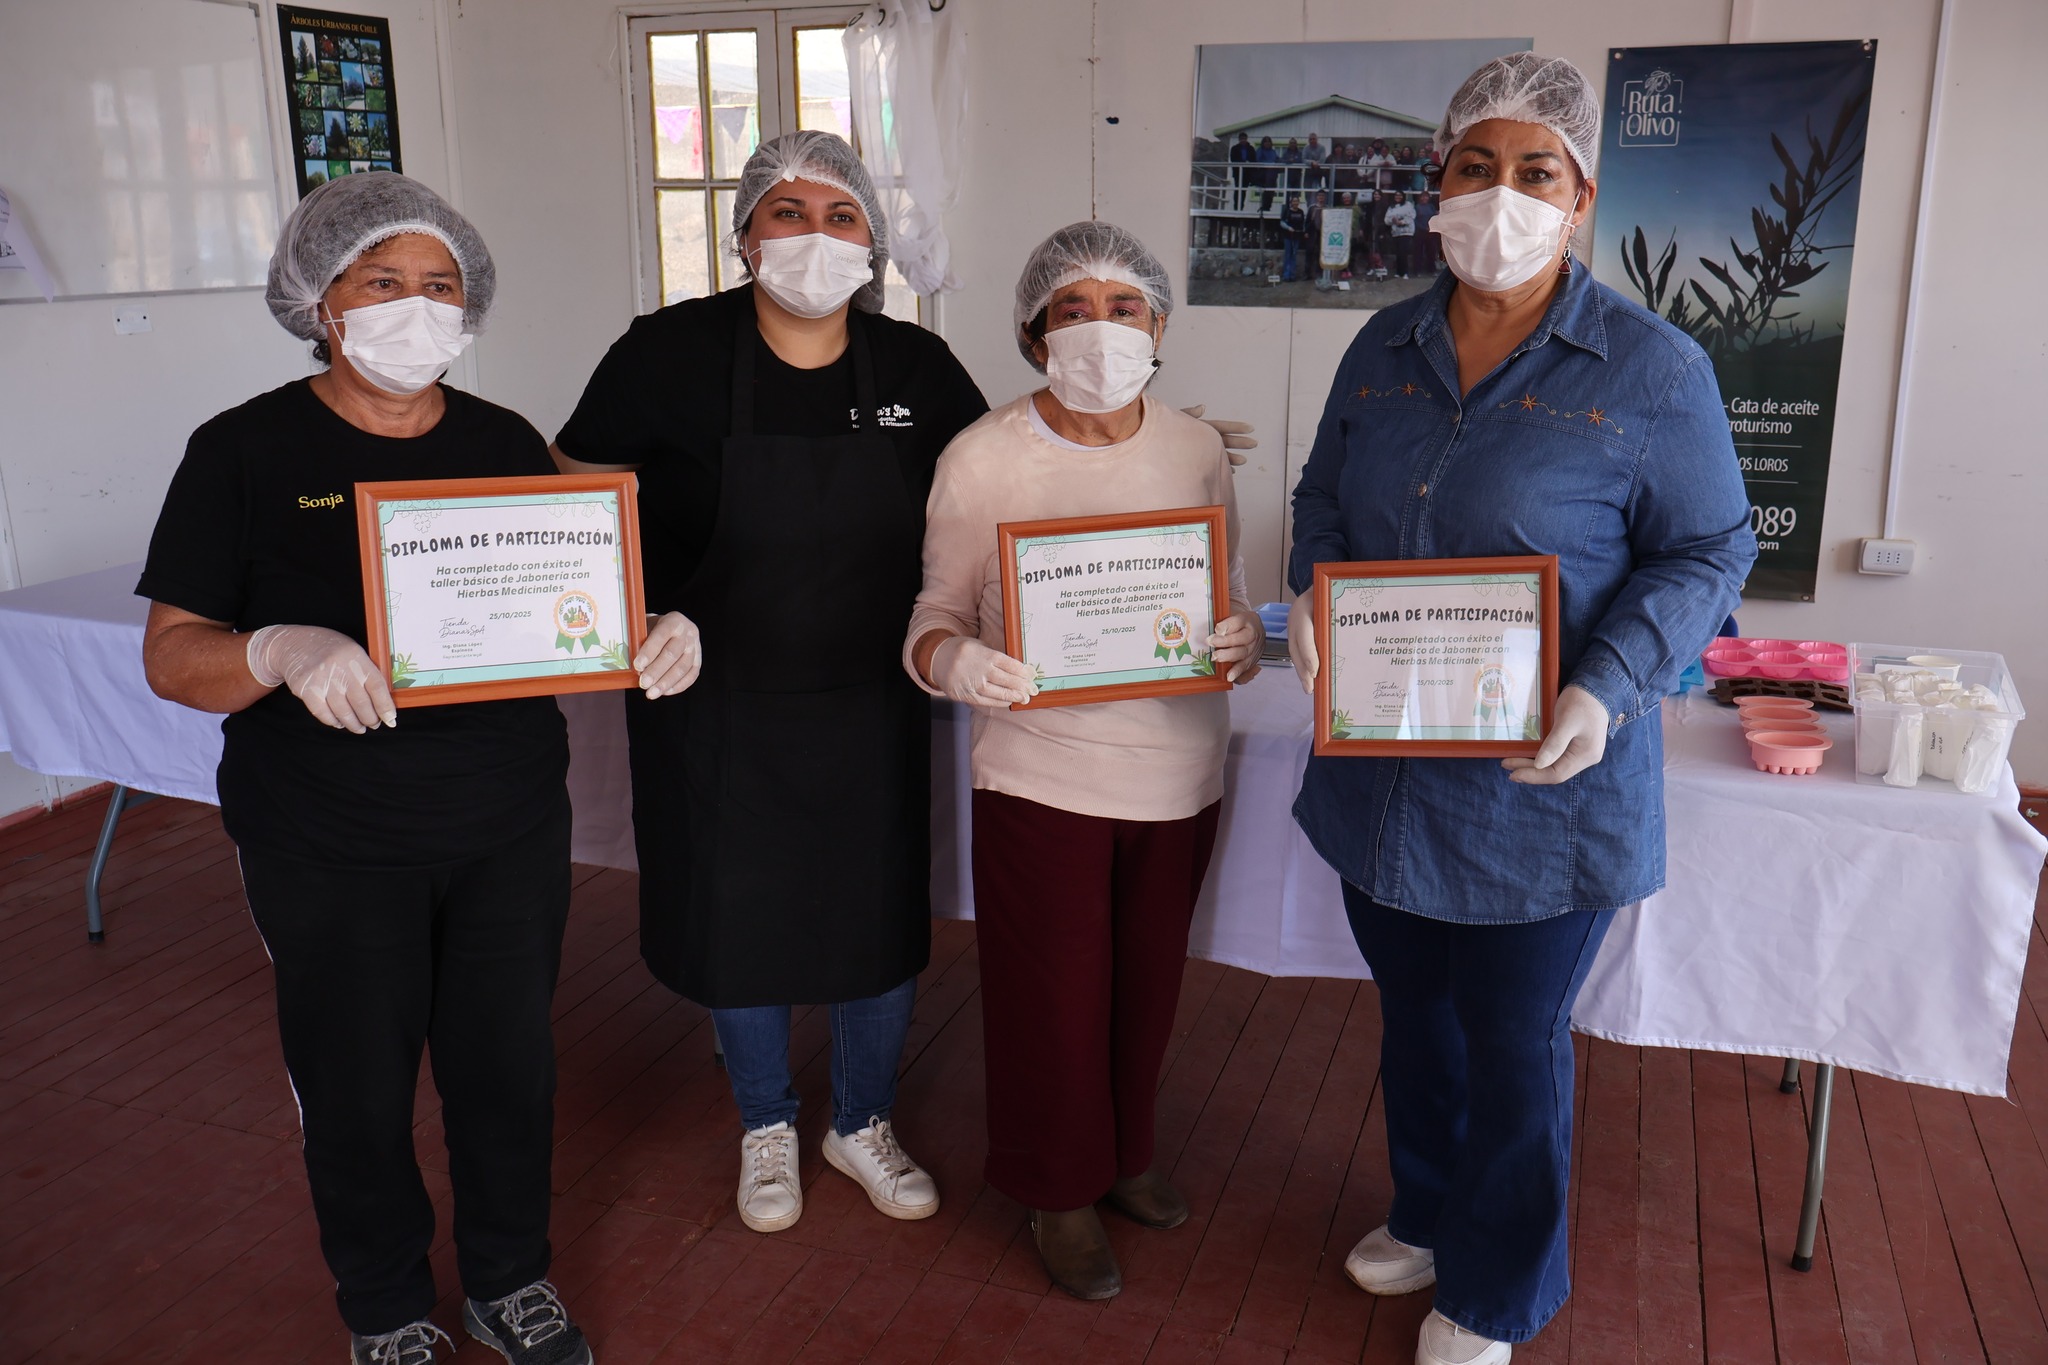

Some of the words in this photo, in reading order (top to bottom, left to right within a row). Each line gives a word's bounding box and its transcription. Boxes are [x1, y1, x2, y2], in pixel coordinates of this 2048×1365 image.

[290, 13, 320, 27] ÁRBOLES
[321, 19, 350, 30] URBANOS
[360, 24, 377, 33] CHILE
[1629, 91, 1674, 113] Ruta
[1627, 114, 1675, 136] Olivo
[893, 404, 910, 418] Spa
[1731, 397, 1759, 413] Cata
[1762, 398, 1778, 414] de
[1781, 400, 1819, 415] aceite
[1728, 418, 1792, 434] roturismo
[1739, 457, 1752, 470] OS
[1754, 458, 1788, 472] LOROS
[298, 493, 344, 509] Sonja
[391, 536, 463, 557] DIPLOMA
[471, 533, 489, 547] DE
[496, 529, 613, 546] PARTICIPACIÓN
[1756, 541, 1779, 550] om
[437, 567, 450, 575] Ha
[454, 562, 518, 574] completado
[543, 560, 570, 569] éxito
[573, 559, 582, 567] el
[1026, 565, 1082, 584] DIPLOMA
[1088, 562, 1102, 574] DE
[1109, 555, 1204, 572] PARTICIPACIÓN
[431, 578, 461, 587] taller
[463, 575, 498, 585] básico
[501, 575, 513, 584] de
[516, 572, 568, 583] Jabonería
[571, 571, 590, 579] con
[457, 588, 499, 598] Hierbas
[502, 584, 564, 596] Medicinales
[1074, 586, 1126, 596] completado
[1056, 600, 1079, 608] taller
[1082, 597, 1109, 606] básico
[1124, 593, 1166, 602] Jabonería
[489, 612, 531, 620] 25/10/2025
[1077, 608, 1110, 617] Hierbas
[1112, 603, 1163, 614] Medicinales
[1340, 610, 1399, 627] DIPLOMA
[1406, 609, 1421, 621] DE
[1428, 607, 1534, 623] PARTICIPACIÓN
[1102, 626, 1136, 634] 25/10/2025
[1375, 636, 1387, 644] Ha
[1389, 636, 1445, 645] completado
[1396, 646, 1426, 654] básico
[1429, 646, 1440, 654] de
[1442, 646, 1490, 654] Jabonería
[1429, 657, 1485, 665] Medicinales
